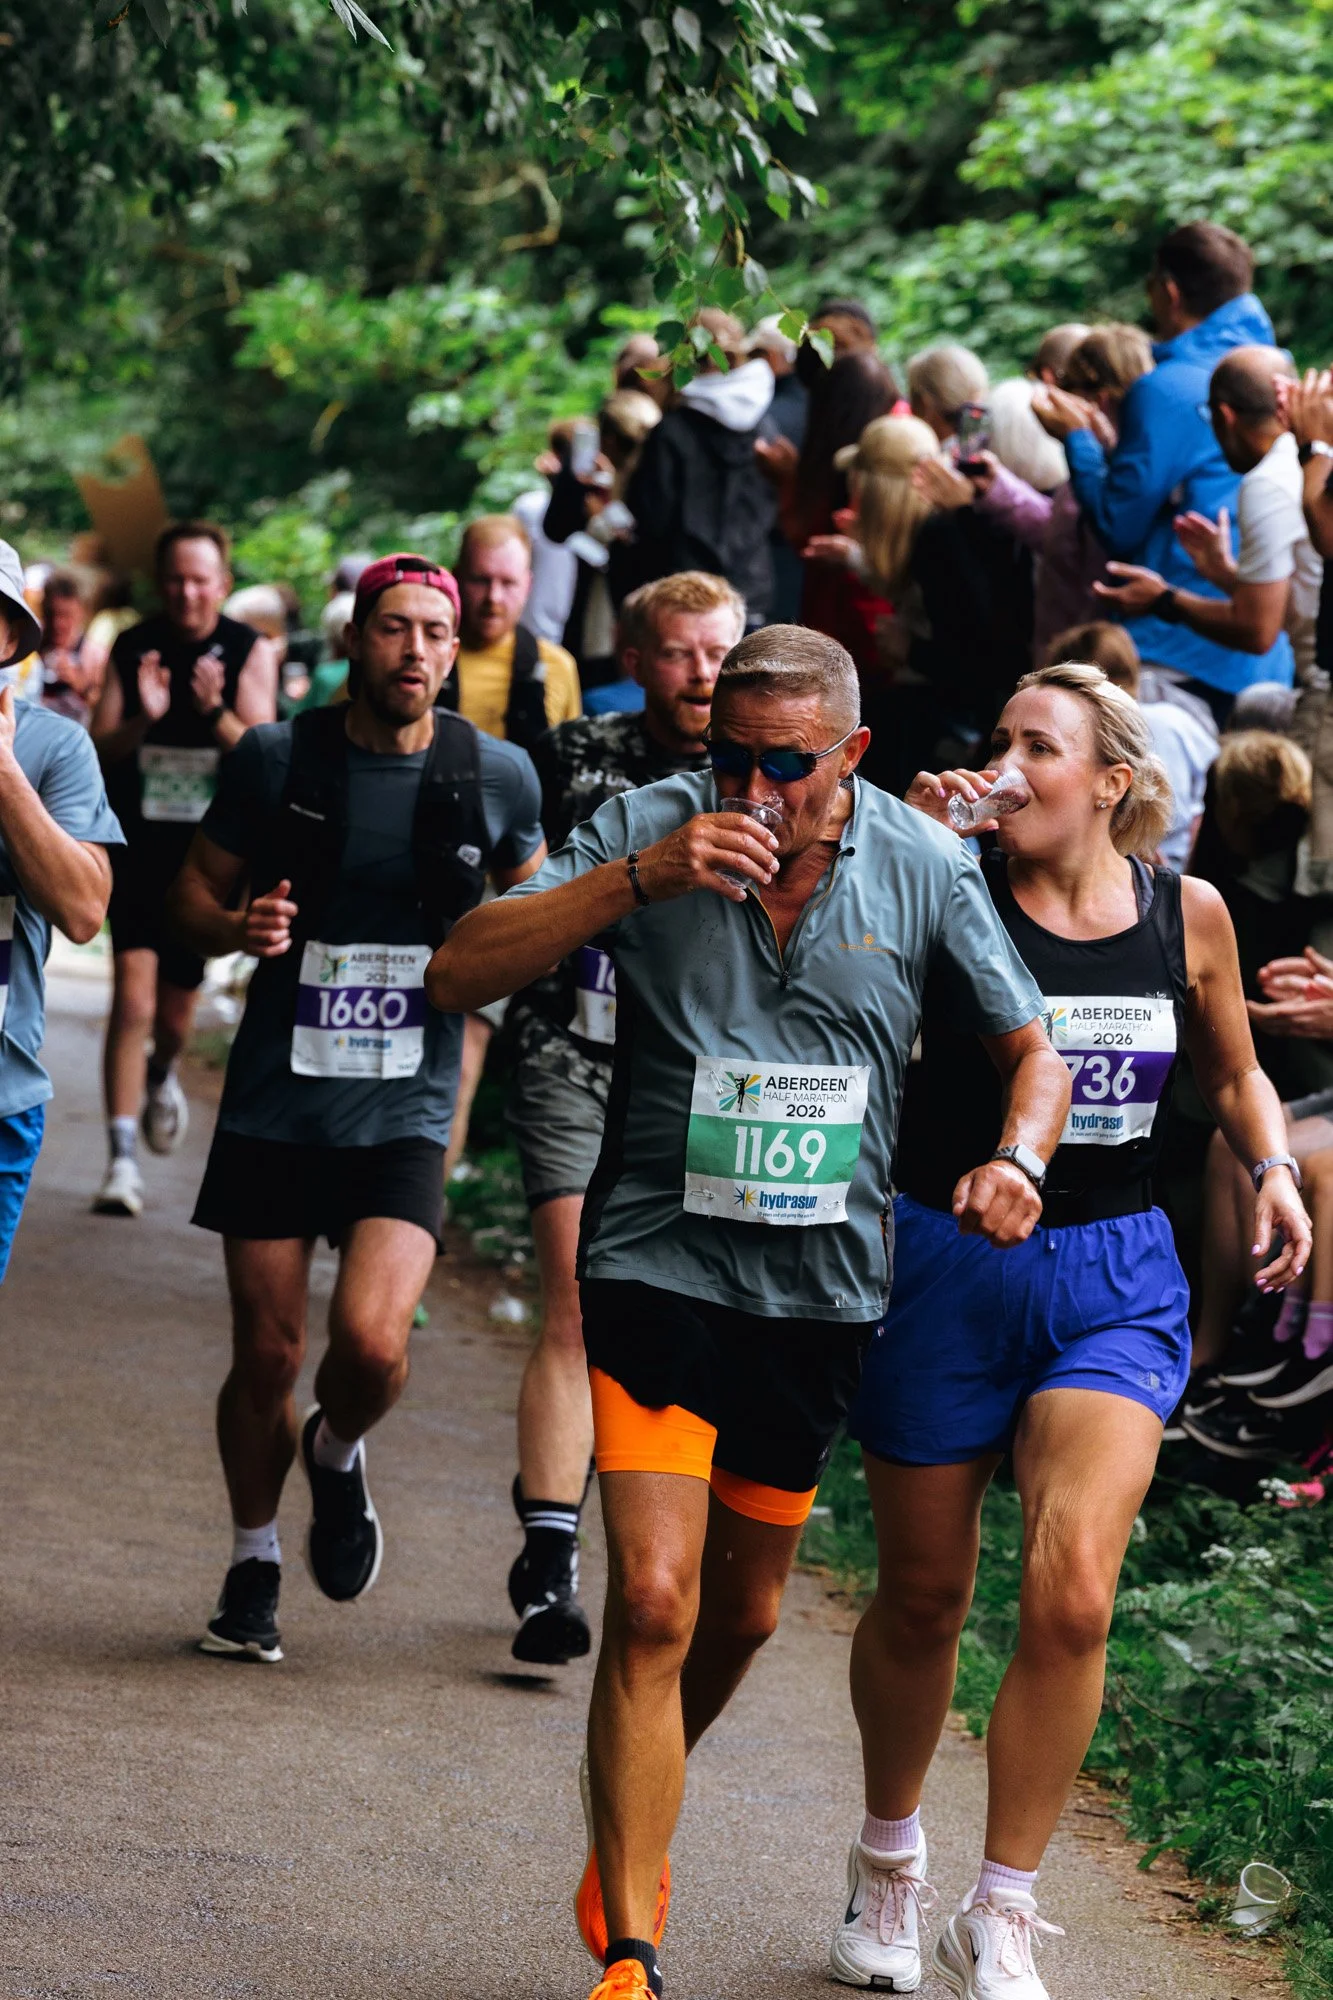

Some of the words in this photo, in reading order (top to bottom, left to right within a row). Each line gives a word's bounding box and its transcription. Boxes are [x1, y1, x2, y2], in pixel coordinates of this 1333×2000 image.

[350, 953, 416, 964] ABERDEEN
[319, 990, 408, 1027] 1660
[1071, 1008, 1152, 1021] ABERDEEN
[1070, 1022, 1096, 1031] HALF
[1093, 1032, 1133, 1046] 2026
[764, 1076, 848, 1091] ABERDEEN
[1062, 1055, 1136, 1100] 736
[763, 1091, 791, 1102] HALF
[793, 1092, 847, 1103] MARATHON
[786, 1104, 826, 1118] 2026
[734, 1126, 827, 1179] 1169
[759, 1191, 818, 1210] hydrasun
